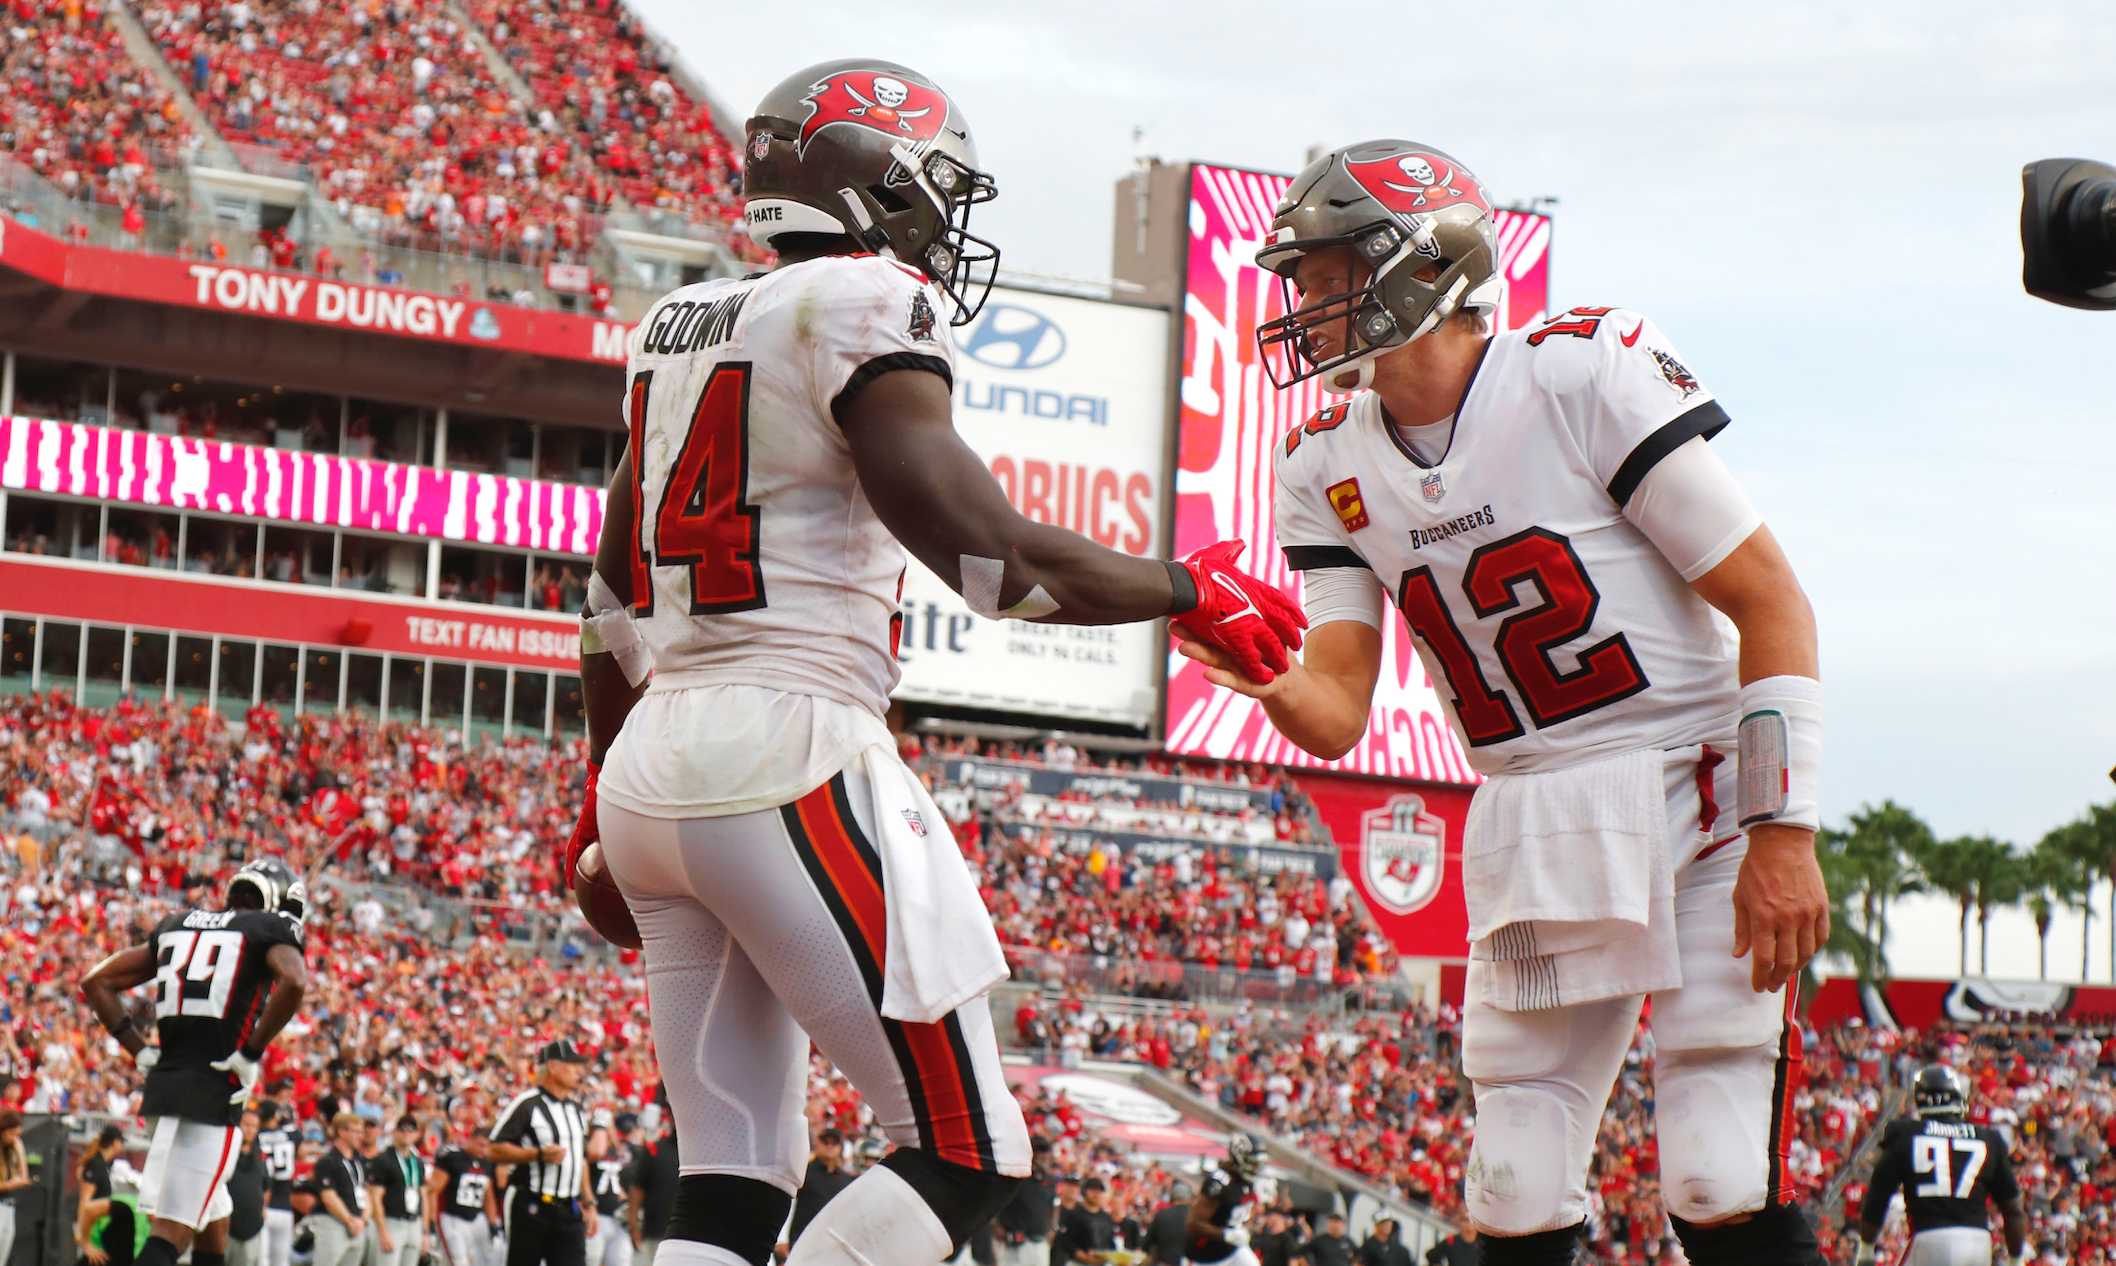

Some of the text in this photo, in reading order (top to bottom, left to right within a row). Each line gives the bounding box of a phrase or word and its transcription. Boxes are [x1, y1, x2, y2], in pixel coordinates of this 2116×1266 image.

[754, 207, 782, 222] HATE
[189, 264, 465, 337] TONY DUNGY
[643, 285, 756, 355] GODWIN
[954, 379, 1110, 426] UNDAI
[630, 360, 767, 618] 14
[1330, 482, 1361, 521] C
[1424, 483, 1443, 497] NFL
[1409, 504, 1495, 550] BUCCANEERS
[406, 616, 466, 648] TEXT
[469, 622, 516, 655] FAN
[896, 600, 973, 663] ite
[1399, 525, 1651, 747] 12
[183, 909, 237, 929] GREEN
[1912, 1134, 1989, 1199] 97
